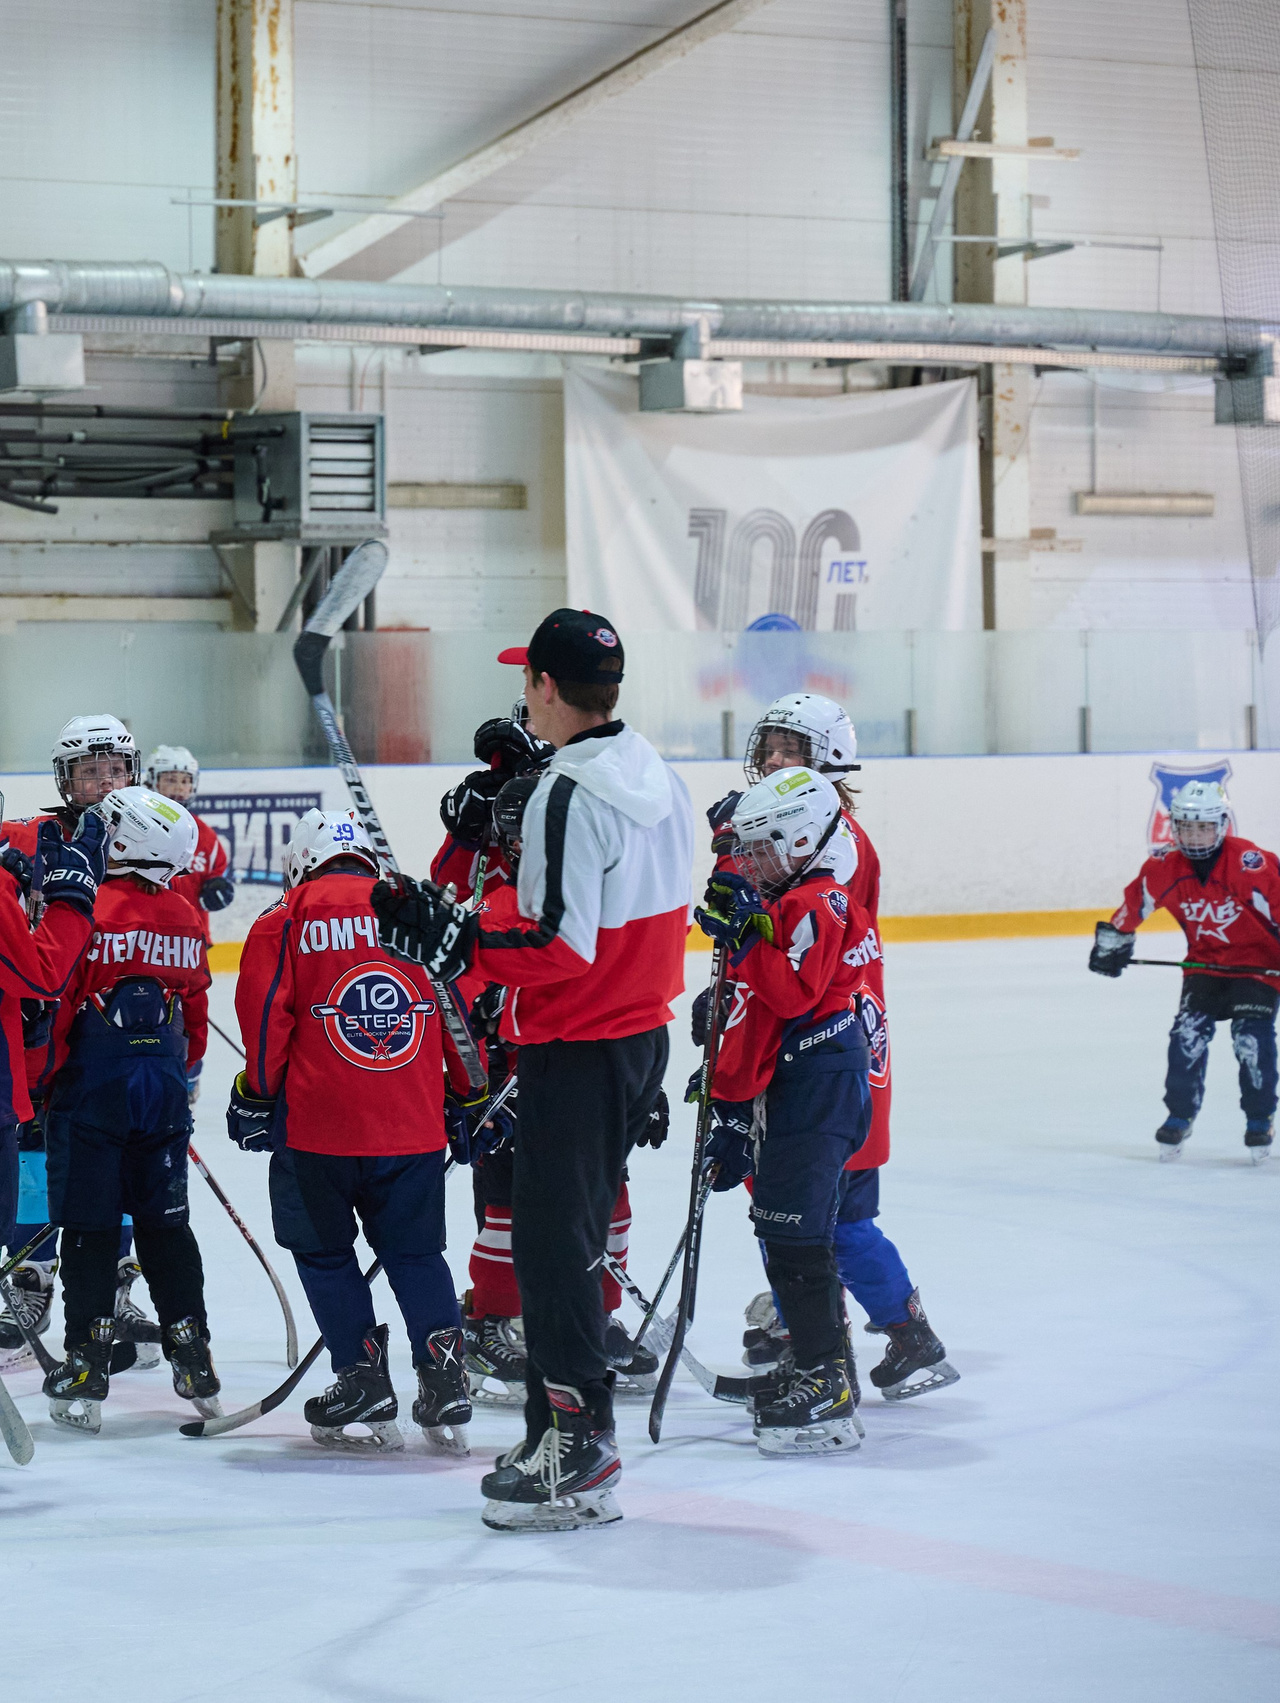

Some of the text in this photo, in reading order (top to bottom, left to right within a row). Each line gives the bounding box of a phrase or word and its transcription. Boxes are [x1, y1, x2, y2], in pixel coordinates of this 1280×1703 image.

[343, 763, 399, 877] SOYUZ
[87, 930, 202, 969] СТЕРЧЕНК
[298, 916, 381, 955] КОМЧ
[356, 984, 399, 1011] 10
[433, 979, 452, 1010] prime
[345, 1014, 412, 1030] STEPS
[799, 1012, 856, 1051] BAUER
[699, 1064, 708, 1095] BAUER
